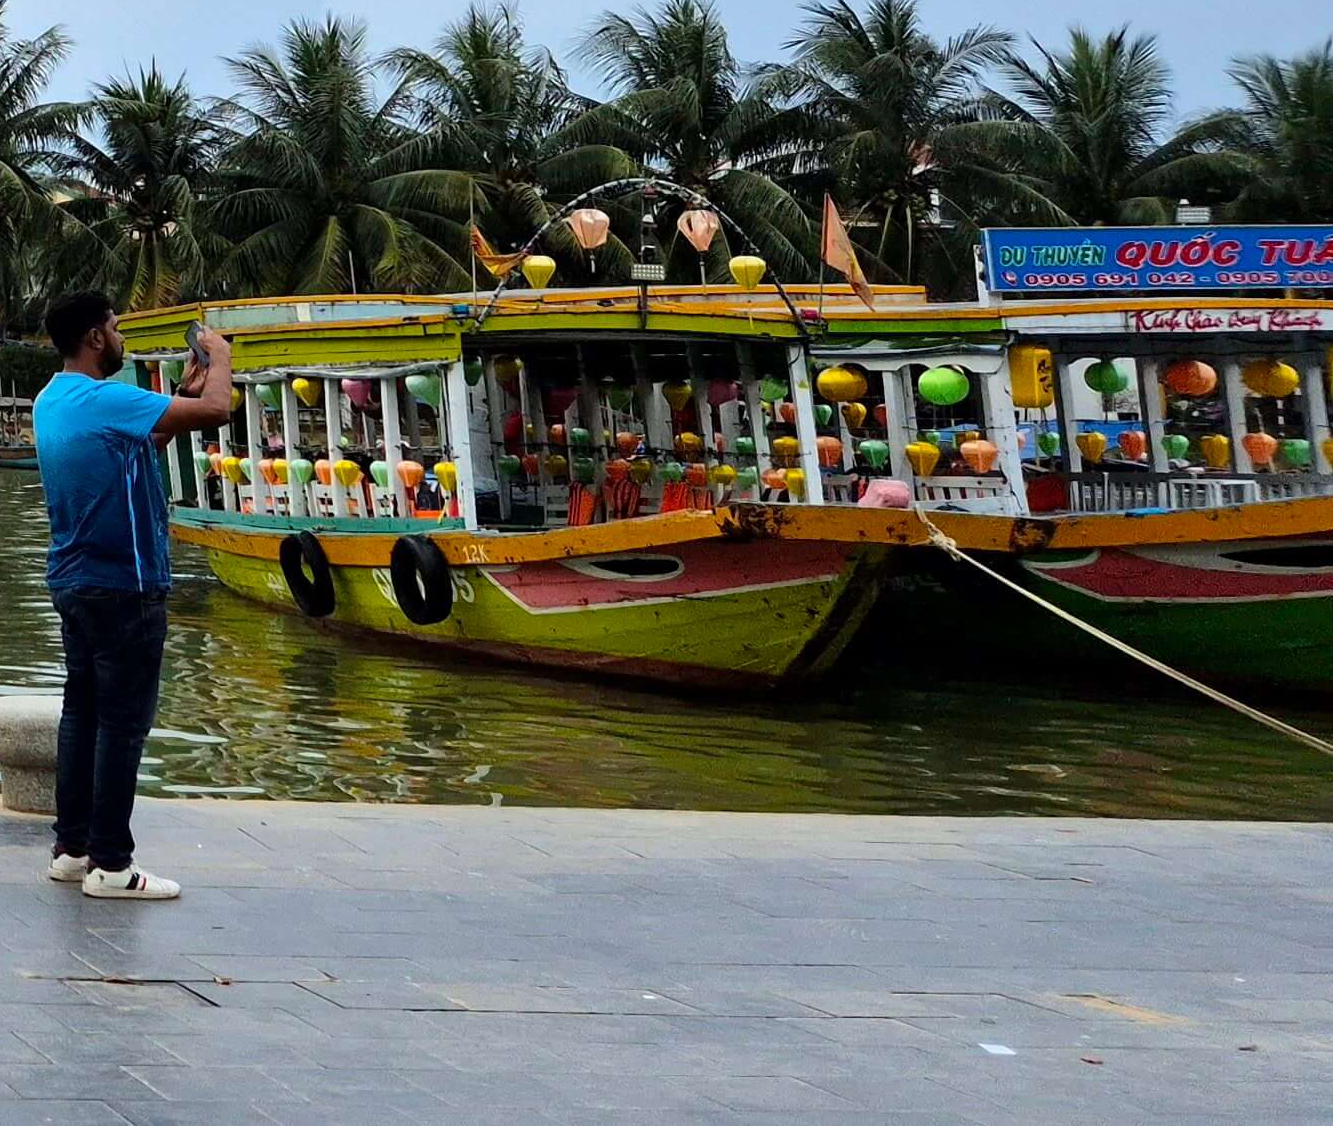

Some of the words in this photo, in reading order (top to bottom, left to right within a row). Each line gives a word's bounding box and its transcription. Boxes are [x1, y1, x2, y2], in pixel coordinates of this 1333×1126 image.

[999, 245, 1027, 267] DU
[1115, 231, 1242, 269] QUỐC
[1024, 272, 1087, 286] 0905
[1093, 271, 1138, 286] 691
[1146, 271, 1195, 286] 042
